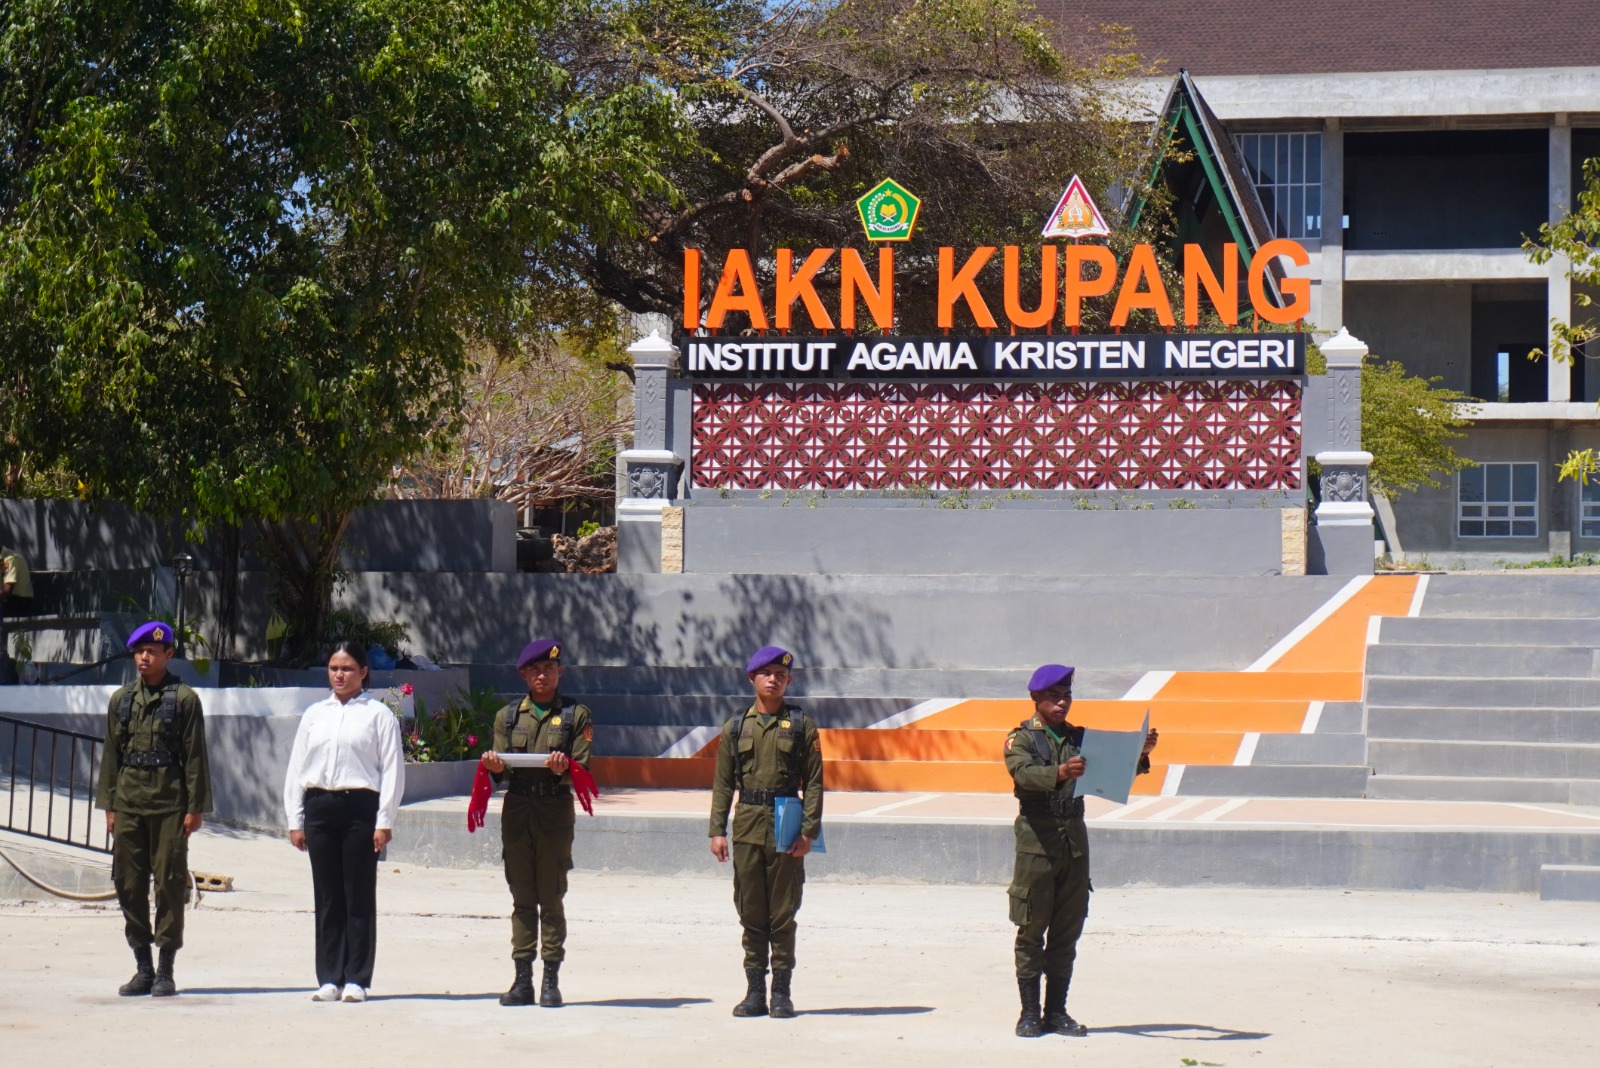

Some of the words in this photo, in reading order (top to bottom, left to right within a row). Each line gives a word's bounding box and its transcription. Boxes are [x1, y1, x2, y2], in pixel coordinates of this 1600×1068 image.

[683, 247, 895, 330] IAKN
[937, 238, 1311, 329] KUPANG
[687, 342, 837, 371] INSTITUT
[846, 341, 978, 371] AGAMA
[994, 340, 1146, 370] KRISTEN
[1164, 339, 1295, 368] NEGERI
